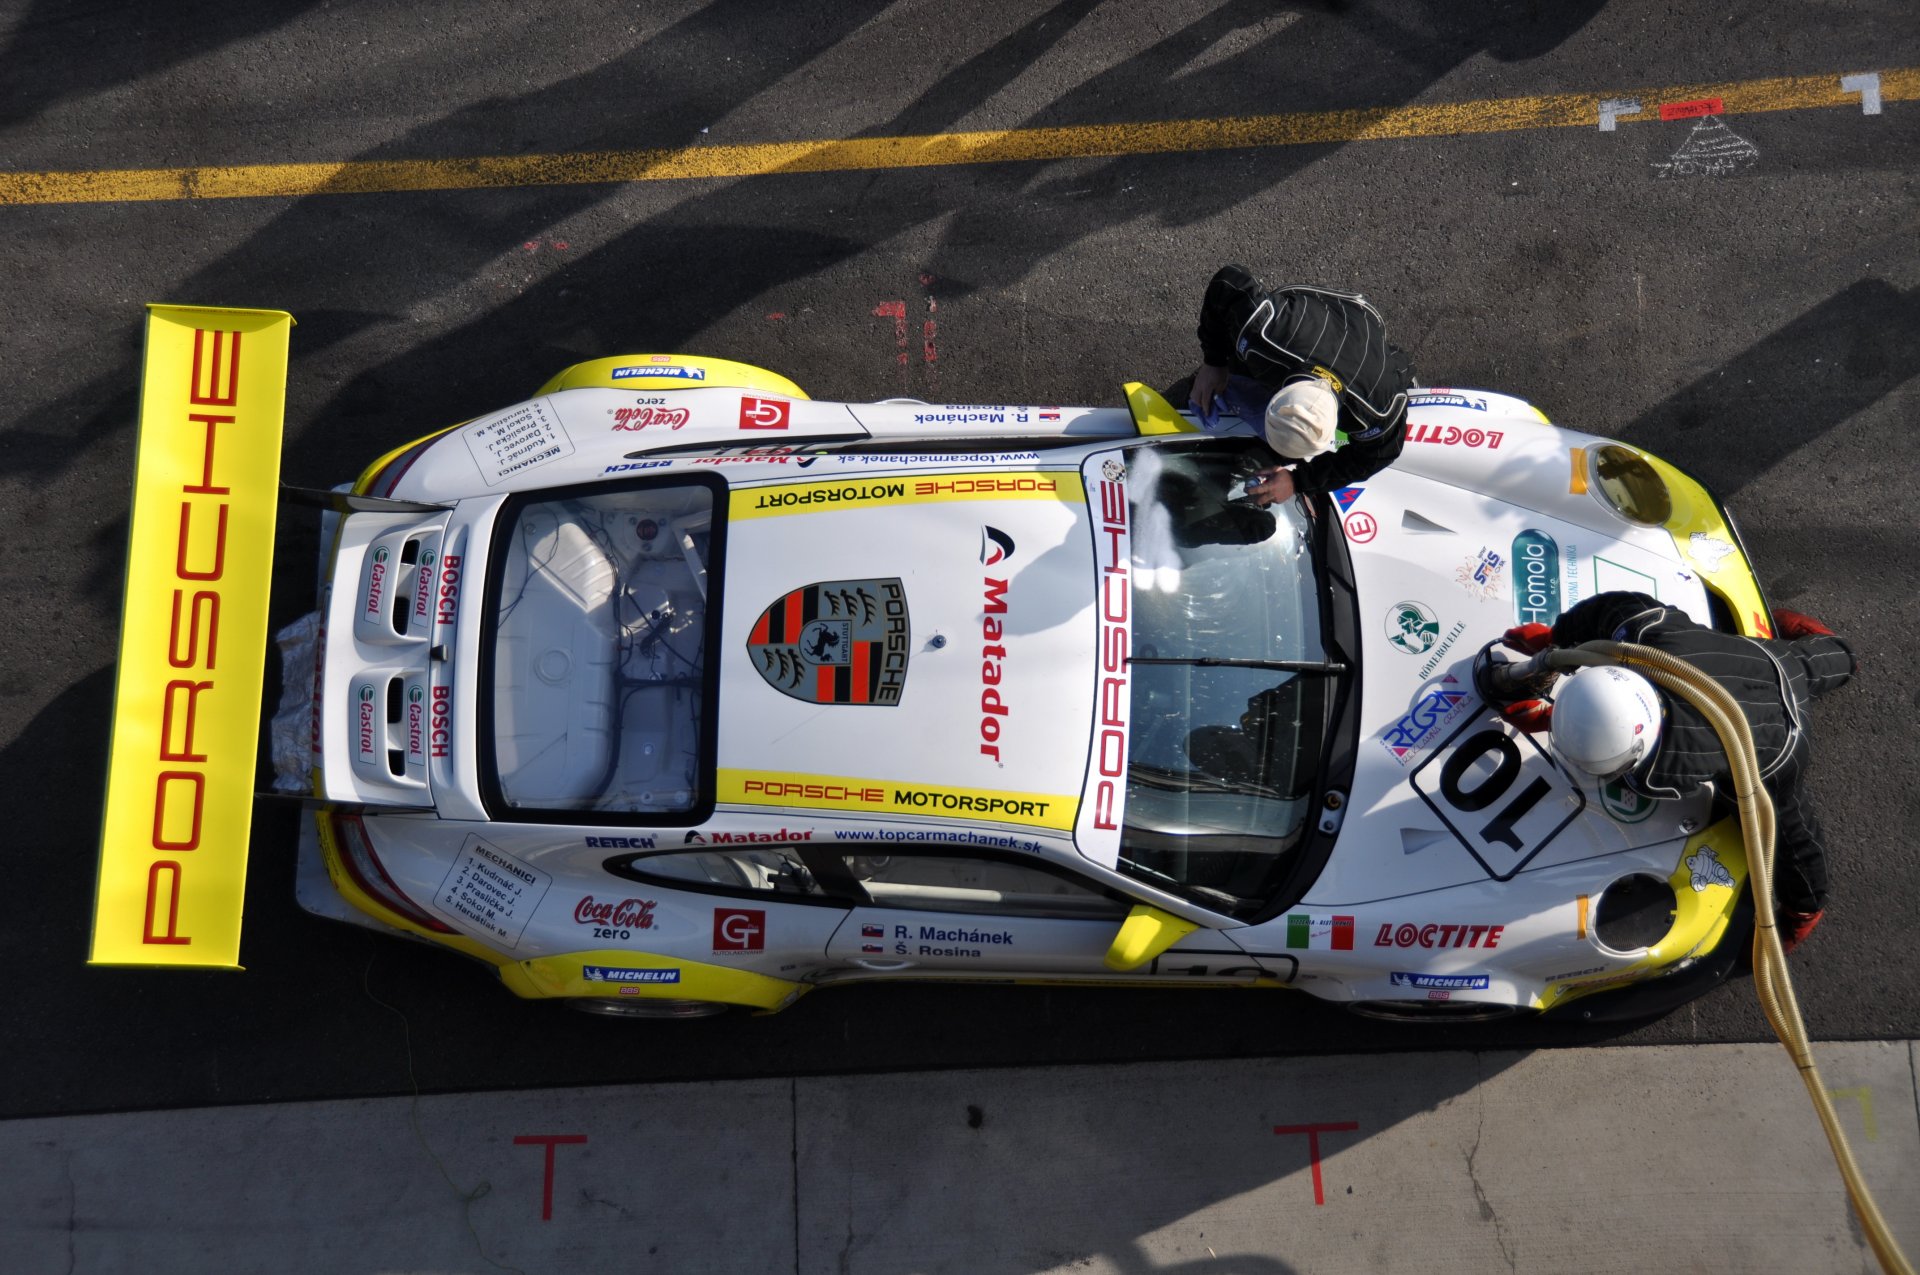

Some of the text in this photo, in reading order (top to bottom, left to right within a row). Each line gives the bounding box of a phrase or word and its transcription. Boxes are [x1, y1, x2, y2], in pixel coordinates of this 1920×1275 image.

[615, 367, 682, 378] MICHELIN
[1409, 395, 1464, 406] MICHEL
[473, 429, 486, 438] M.
[495, 408, 542, 437] 4. Sokol M.
[538, 415, 547, 423] 3.
[544, 423, 552, 431] 2.
[915, 412, 1029, 426] R. Machánek
[485, 443, 494, 452] J.
[504, 430, 542, 453] Darovec
[548, 432, 556, 441] 1.
[1404, 424, 1504, 450] LOCTIT
[497, 457, 505, 465] J.
[498, 445, 561, 477] MECHANICI
[693, 456, 791, 465] Matador
[837, 451, 1040, 466] www.topcarmachanek.sk
[755, 479, 1057, 508] PORSCHE MOTORSPORT
[1565, 544, 1578, 578] TECHNIKA
[368, 564, 385, 615] Castrol
[415, 566, 432, 617] Castrol
[437, 555, 461, 625] BOSCH
[1521, 543, 1547, 626] Homola
[142, 328, 241, 945] PORSCHE
[841, 623, 849, 663] STUTTGART
[878, 583, 906, 700] PORSCHE
[980, 576, 1009, 763] Matador
[1093, 480, 1128, 831] PORSCHE
[361, 702, 374, 754] Castrol
[410, 703, 422, 755] Castrol
[432, 685, 450, 757] BOSCH
[1384, 690, 1468, 753] REGRA
[744, 780, 1049, 818] PORSCHE MOTORSPORT
[1439, 729, 1552, 852] 10
[711, 828, 814, 845] Matador
[834, 829, 1042, 854] www.topcarmachanek.sk
[467, 857, 523, 898] 1. Kudrnáč J.
[475, 845, 537, 884] MECHANICI
[456, 875, 514, 920] 3. Praslička J.
[462, 866, 515, 907] 2. Darovec J.
[451, 886, 497, 922] 4. Sokol M.
[455, 900, 496, 932] Haruštiak
[497, 929, 508, 940] M.
[593, 927, 630, 940] zero
[895, 925, 1013, 945] R. Machánek
[1374, 923, 1505, 948] LOCTITE
[895, 942, 981, 958] Š. Rosina
[607, 970, 677, 981] MICHELIN
[1416, 976, 1486, 989] MICHELIN
[1428, 991, 1449, 999] BBS
